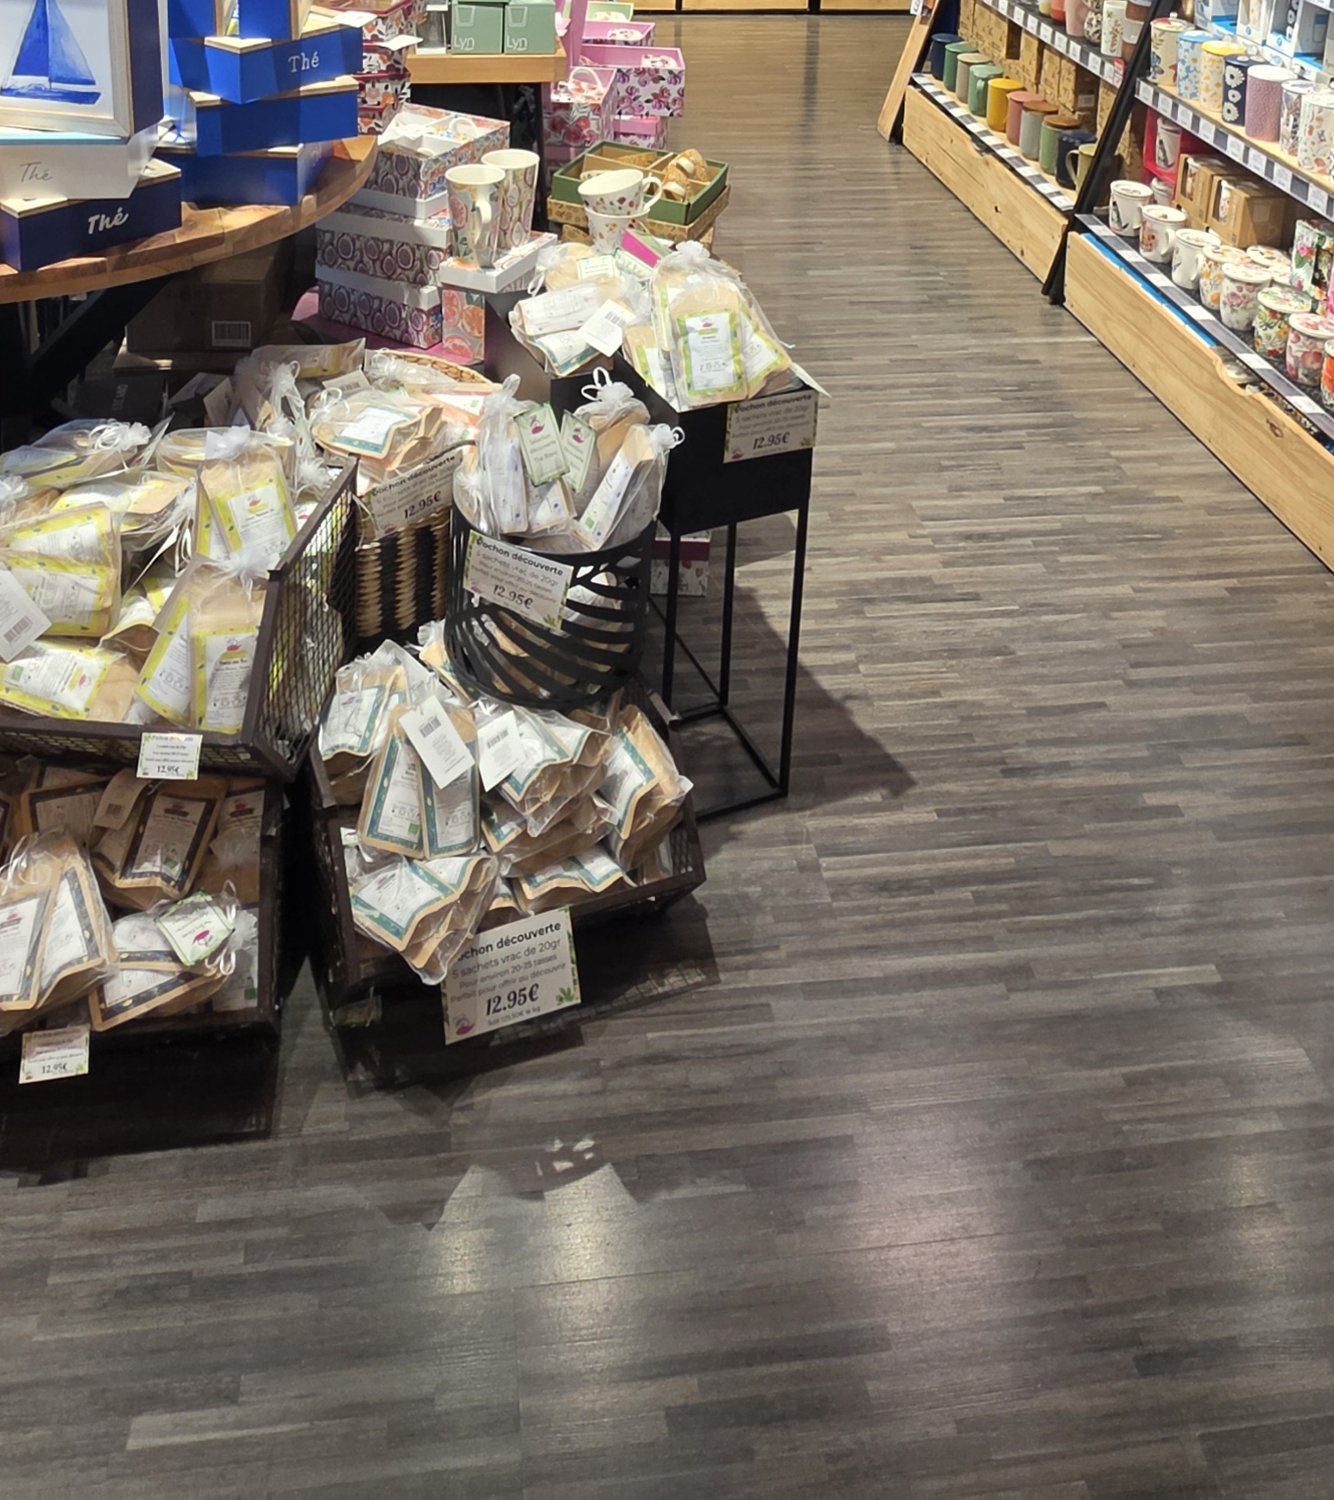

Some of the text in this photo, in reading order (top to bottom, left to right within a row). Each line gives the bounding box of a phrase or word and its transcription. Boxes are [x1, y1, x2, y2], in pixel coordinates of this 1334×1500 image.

[287, 52, 320, 74] Thé
[19, 160, 53, 183] Thé
[87, 206, 130, 235] Thé
[767, 394, 812, 408] découverte
[753, 431, 790, 450] 12.95€
[408, 455, 455, 481] découverte
[404, 490, 442, 519] 12.95€
[512, 553, 564, 576] découverte
[493, 584, 534, 609] 12.95€
[496, 922, 561, 949] découverte
[461, 958, 499, 977] sachets
[501, 950, 522, 964] vrac
[524, 946, 536, 957] de
[538, 939, 561, 953] 20gr
[459, 954, 557, 990] Pour environ 20-25 tasses
[478, 983, 496, 996] pour
[530, 962, 566, 979] découvrir
[486, 983, 540, 1016] 12.95€
